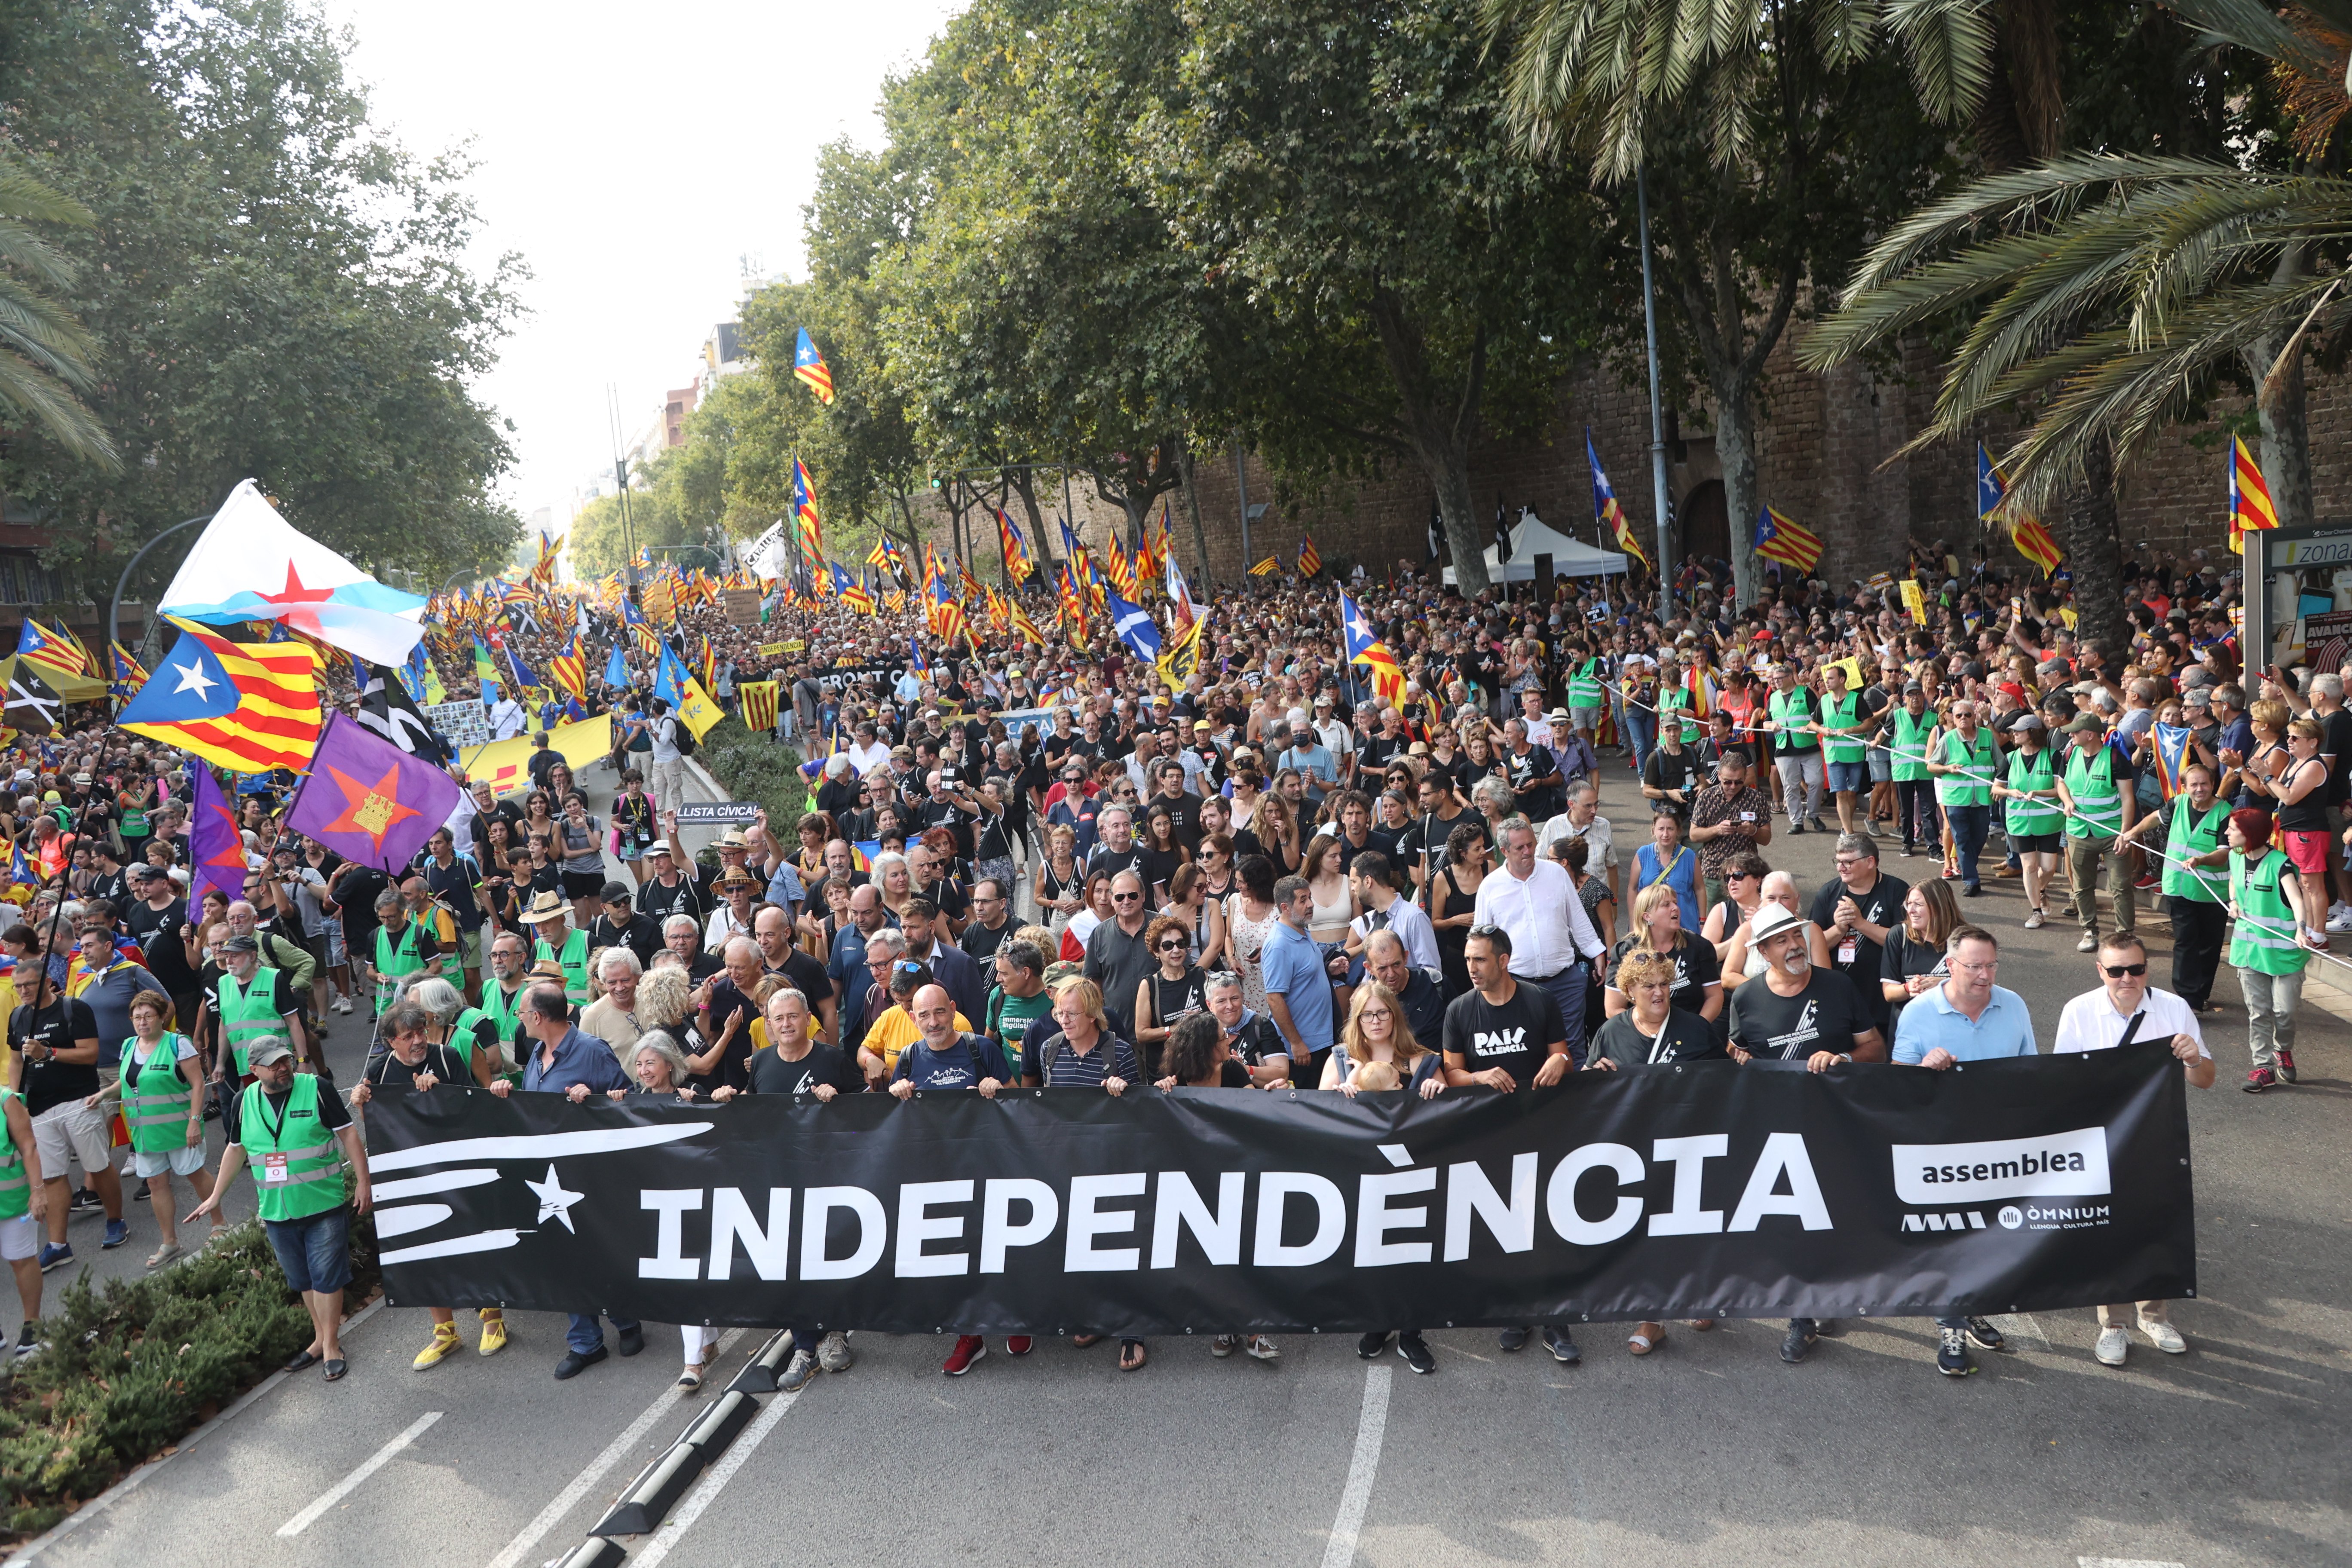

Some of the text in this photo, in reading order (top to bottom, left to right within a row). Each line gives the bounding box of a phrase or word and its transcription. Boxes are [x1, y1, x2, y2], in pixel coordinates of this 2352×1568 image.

[2299, 543, 2352, 563] zona
[762, 642, 802, 653] INDEPENDÈNCIA
[2306, 640, 2326, 648] CAP
[1006, 718, 1056, 735] CATA
[941, 768, 946, 776] LA
[677, 805, 757, 817] LLISTA CÍVICA!
[1474, 1026, 1526, 1048] PAÍS
[1767, 1033, 1792, 1042] TORNEM-HI
[1769, 1031, 1819, 1047] INDEPENDÈNCIA
[1475, 1043, 1528, 1056] VALENCIÀ
[1012, 1053, 1021, 1062] UST
[1922, 1151, 2085, 1183] assemblea
[638, 1133, 1833, 1280] INDEPENDÈNCIA
[2027, 1205, 2109, 1221] ÒMNIUM
